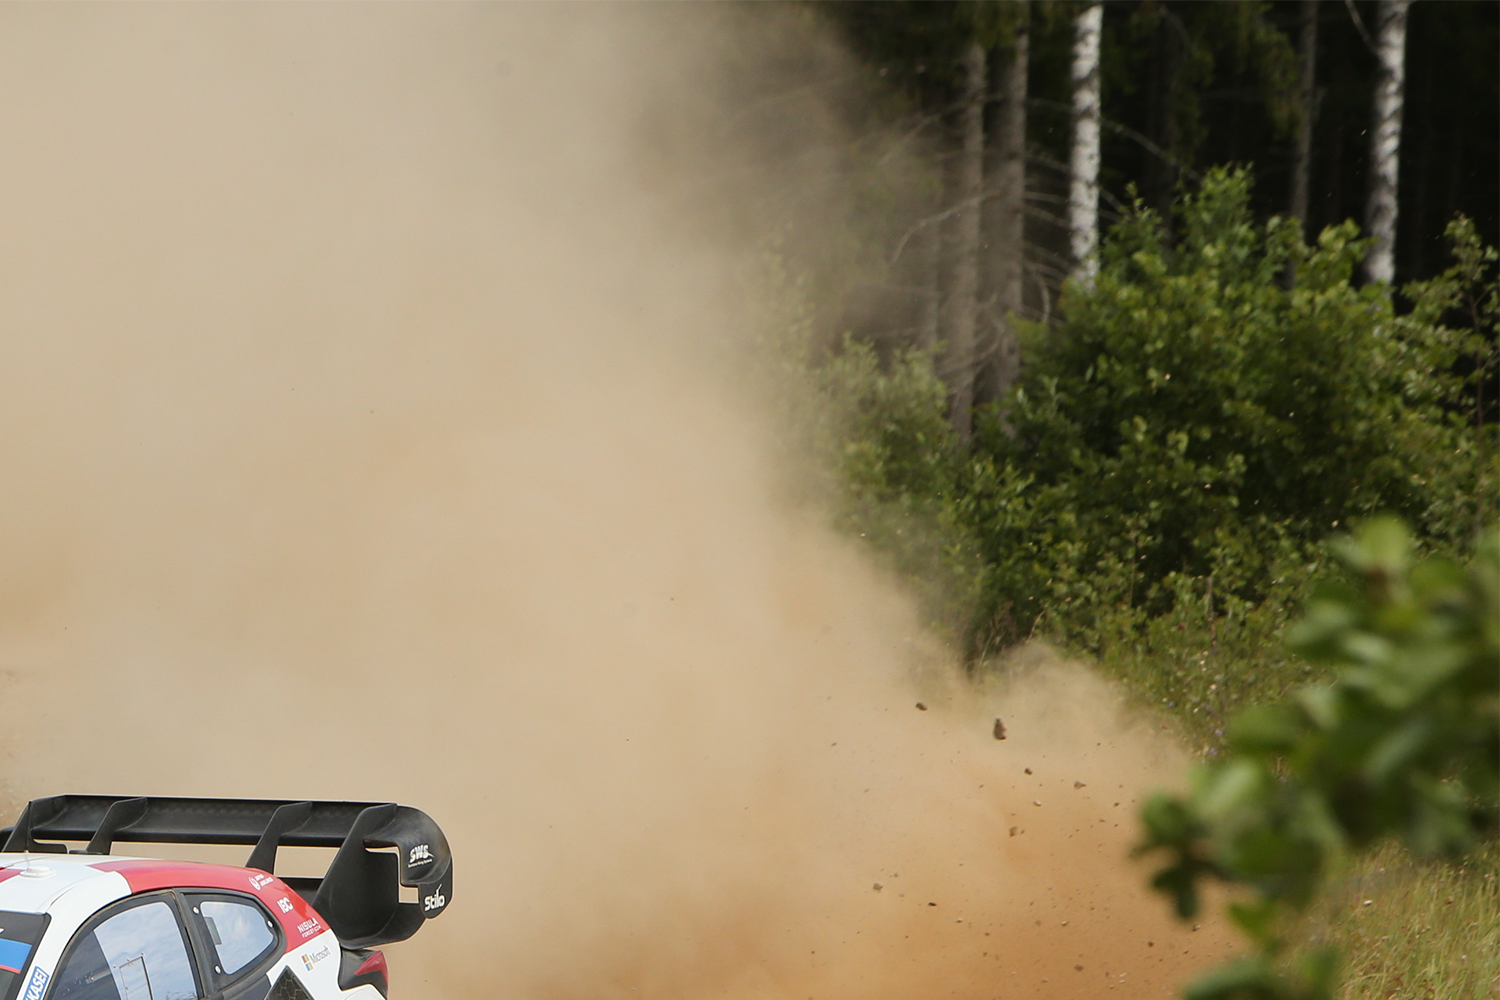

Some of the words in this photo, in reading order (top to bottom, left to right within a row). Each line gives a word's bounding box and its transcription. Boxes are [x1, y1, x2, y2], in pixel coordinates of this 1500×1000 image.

[409, 844, 433, 863] SWS
[424, 883, 445, 911] Stilo
[296, 917, 319, 933] NISULA
